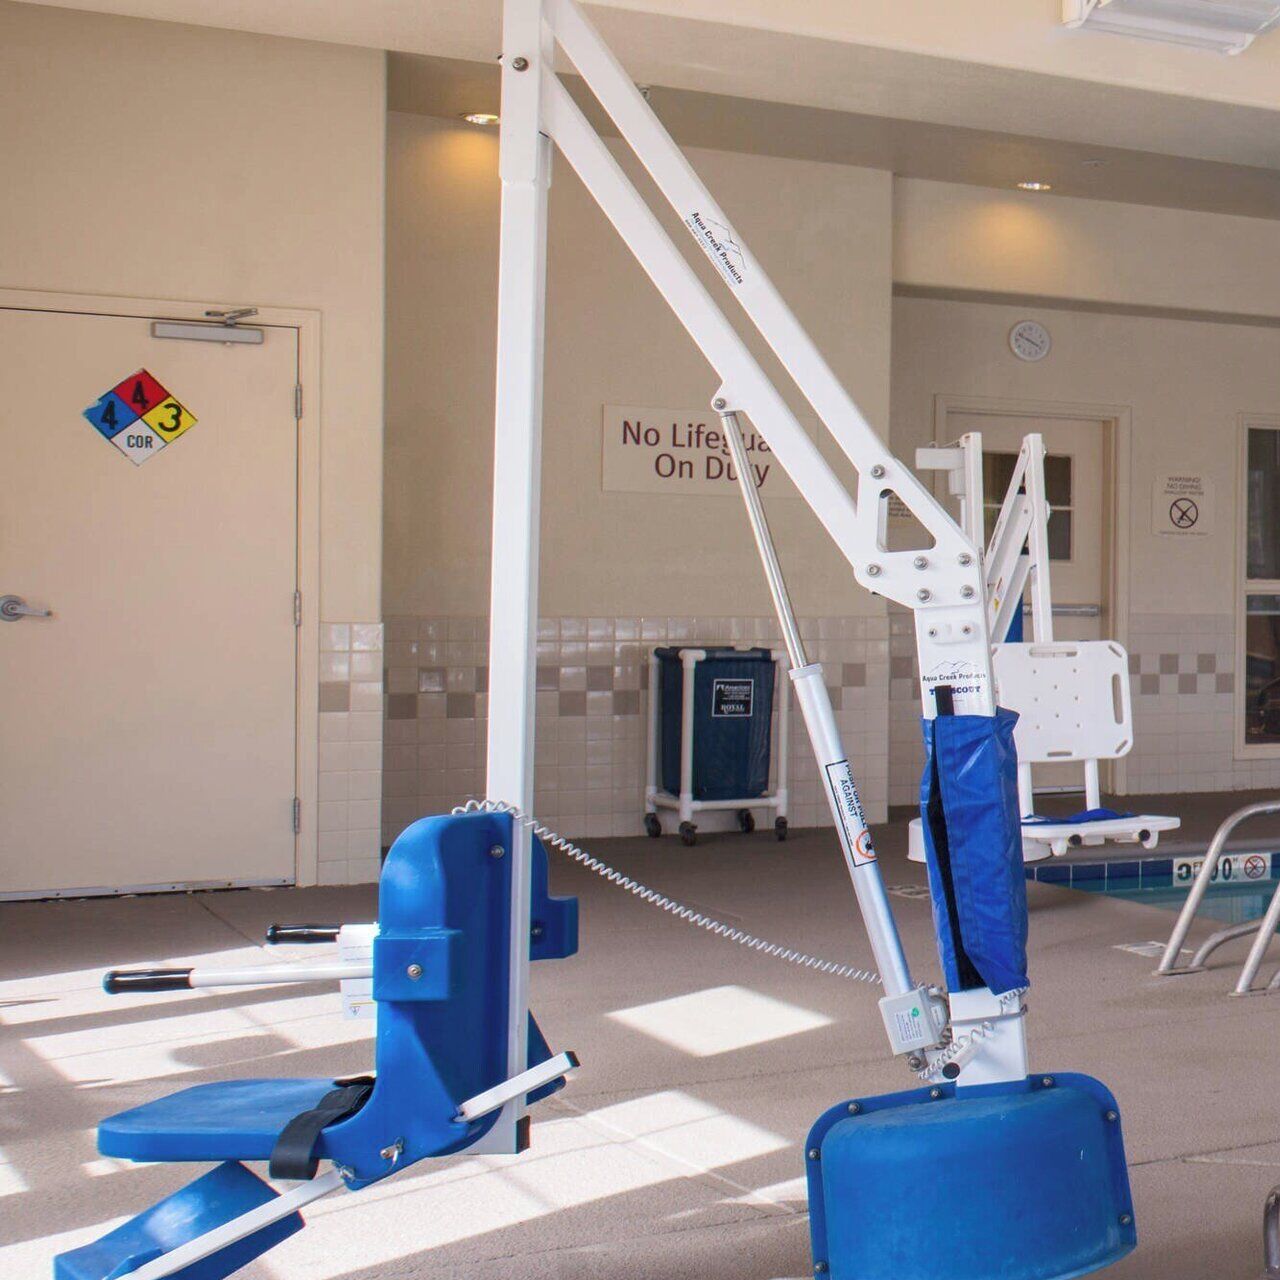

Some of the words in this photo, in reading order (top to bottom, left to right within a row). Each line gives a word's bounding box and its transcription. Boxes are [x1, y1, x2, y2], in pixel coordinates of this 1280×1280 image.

[692, 212, 706, 231] Aqua
[704, 229, 722, 252] Creek
[719, 251, 744, 284] Products
[132, 381, 149, 410] 4
[101, 400, 119, 430] 4
[158, 402, 182, 432] 3
[126, 434, 154, 449] COR
[622, 420, 660, 447] No
[654, 453, 693, 480] On
[706, 456, 770, 487] Duy
[939, 674, 957, 682] Creek
[841, 779, 859, 818] AGAINST
